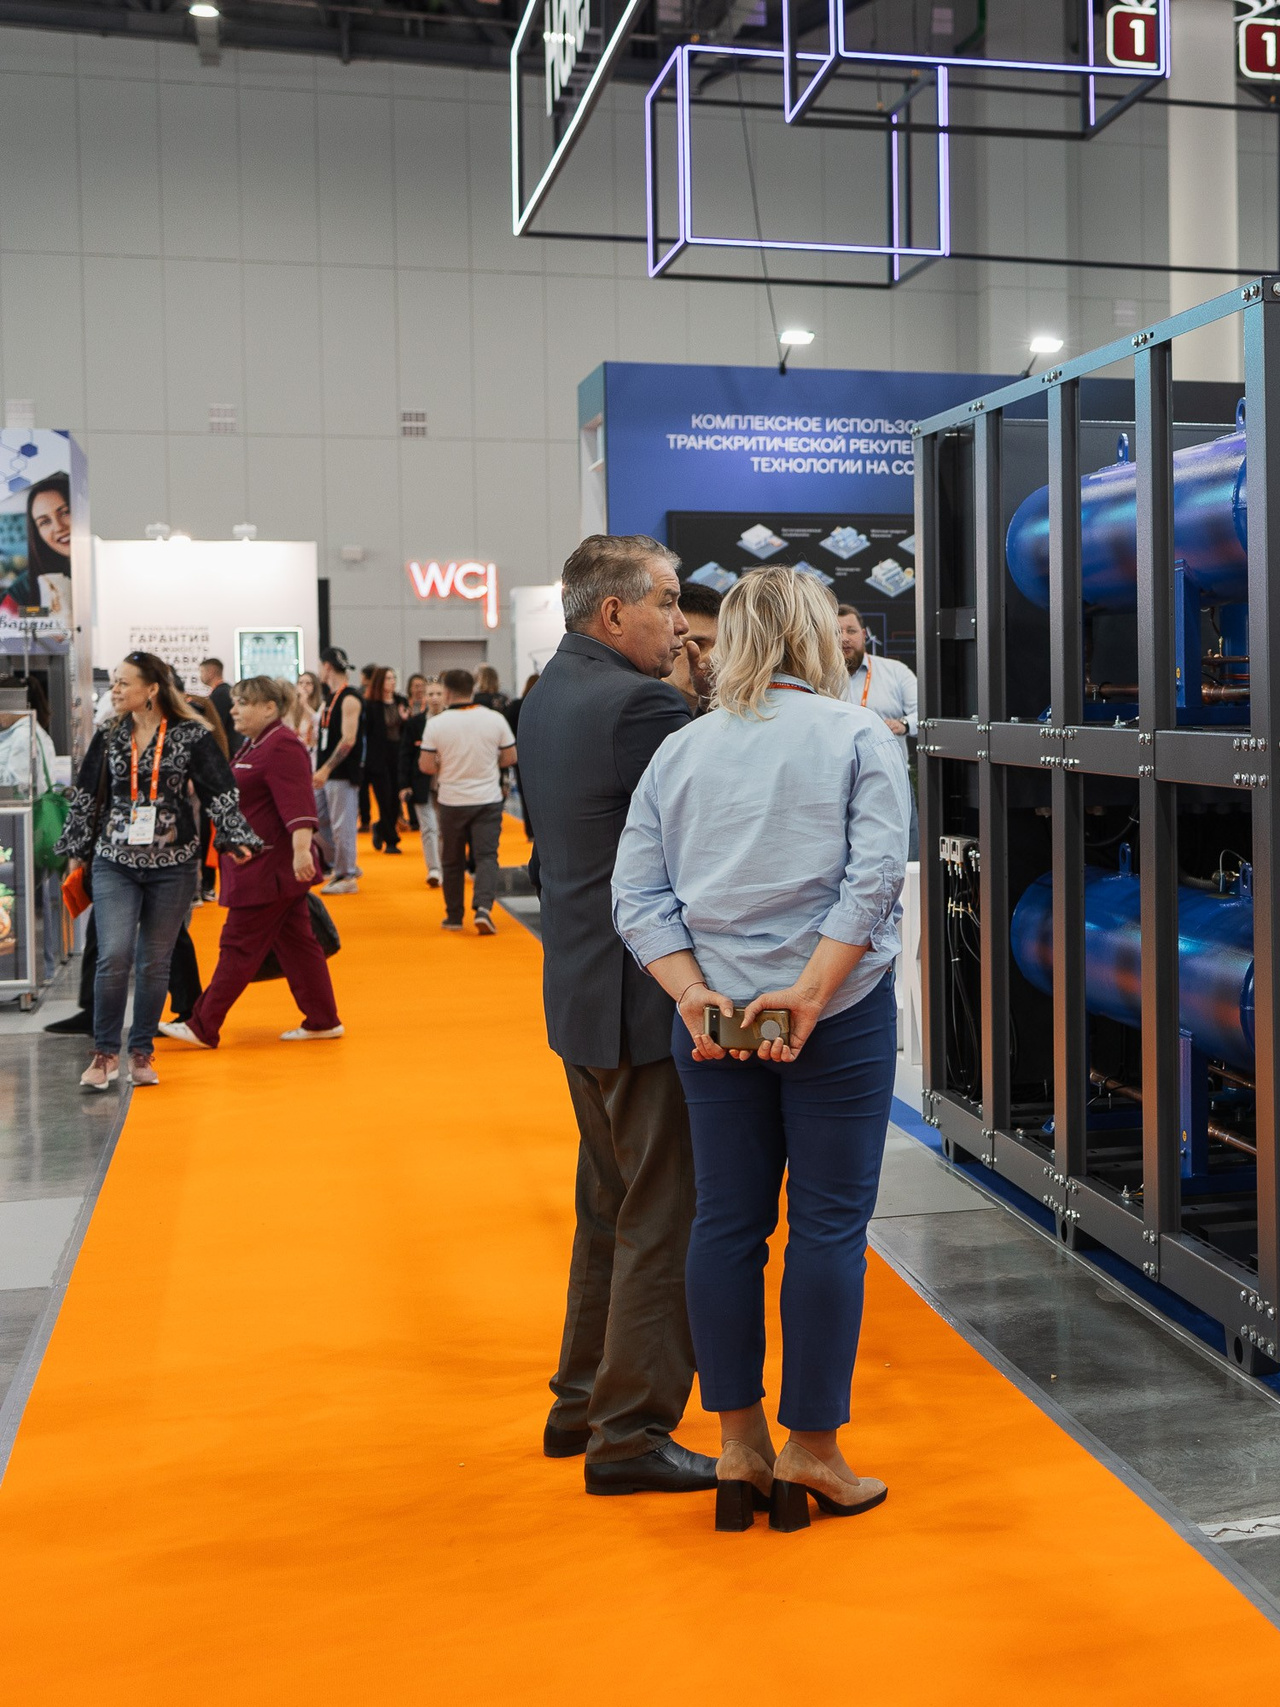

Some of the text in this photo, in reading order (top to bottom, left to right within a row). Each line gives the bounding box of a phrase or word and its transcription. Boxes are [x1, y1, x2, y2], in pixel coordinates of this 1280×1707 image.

[1129, 19, 1146, 56] 1
[1261, 31, 1277, 67] 1
[691, 413, 917, 435] КОМПЛЕКСНОЕ ИСПОЛЬЗО
[666, 433, 914, 455] ТРАНСКРИТИЧЕСКОЙ РЕКУПЕ
[750, 456, 863, 475] ТЕХНОЛОГИИ
[866, 459, 890, 475] НА
